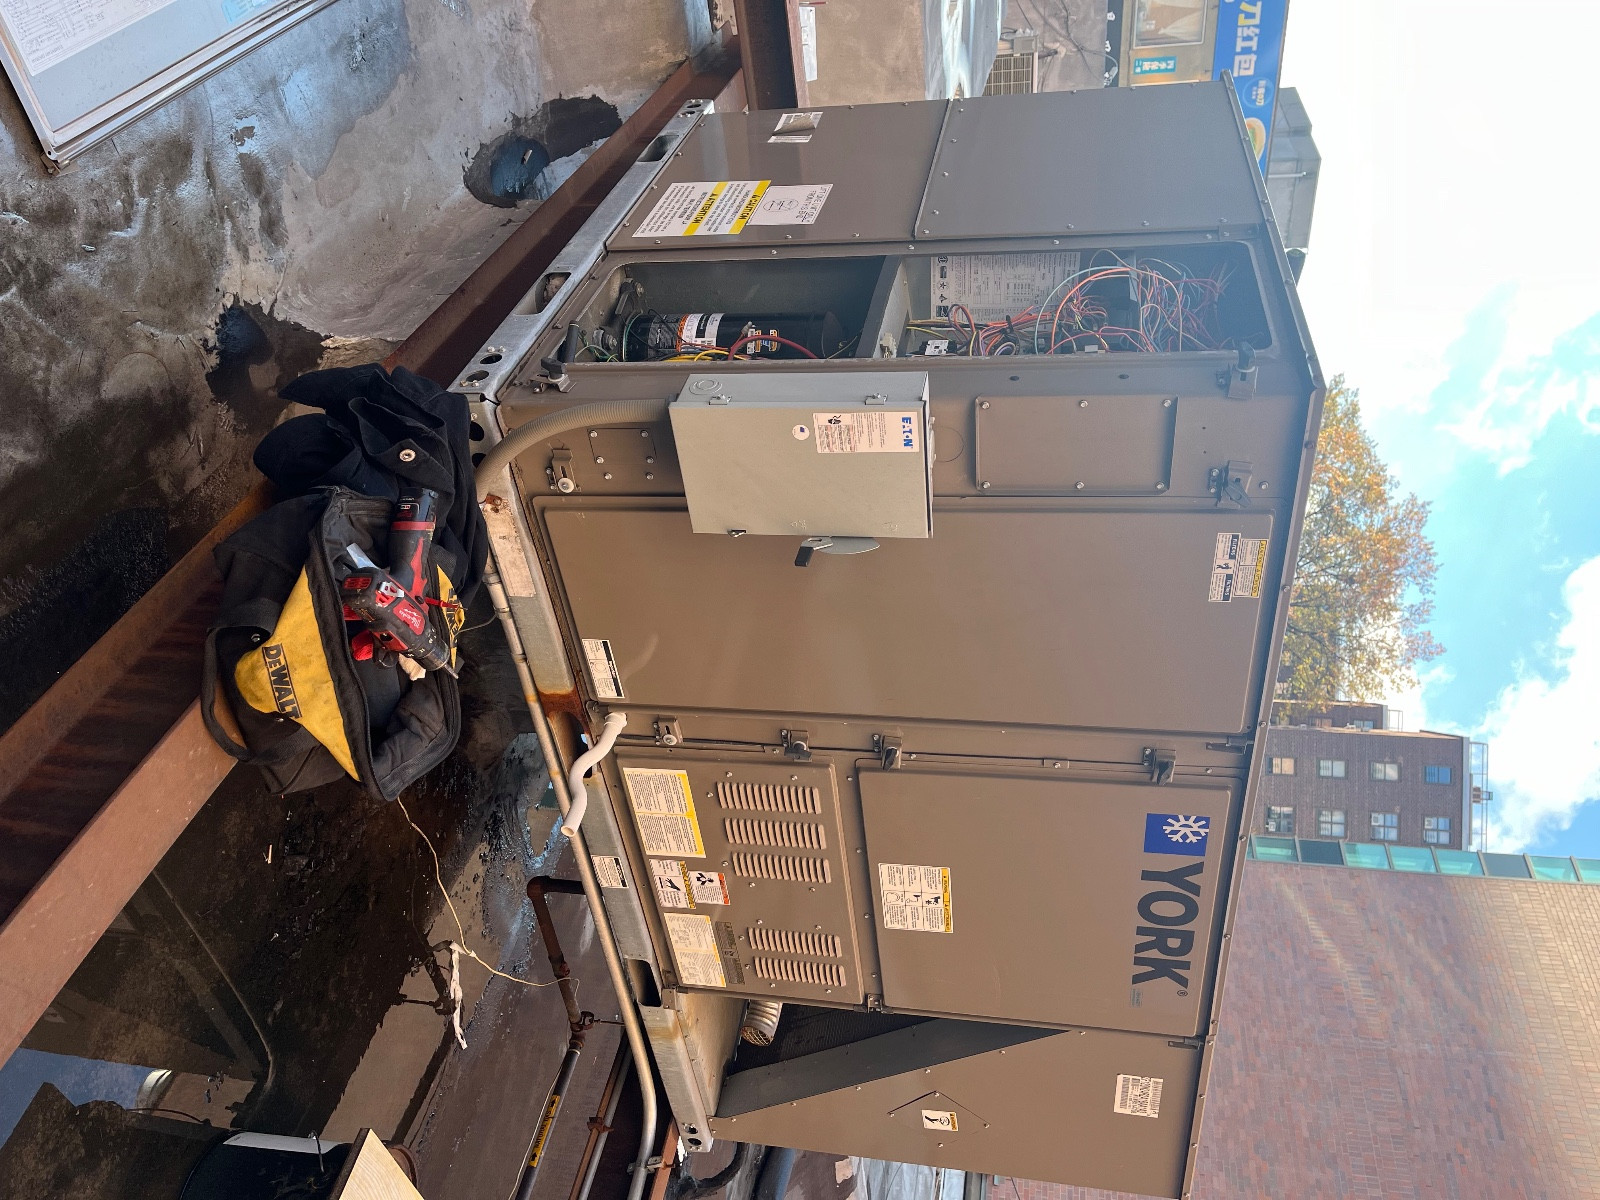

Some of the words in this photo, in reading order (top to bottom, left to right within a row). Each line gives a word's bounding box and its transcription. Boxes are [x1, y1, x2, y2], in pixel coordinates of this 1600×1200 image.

[692, 198, 716, 224] ATTENTION
[738, 198, 760, 220] CAUTION
[1132, 861, 1204, 989] YORK
